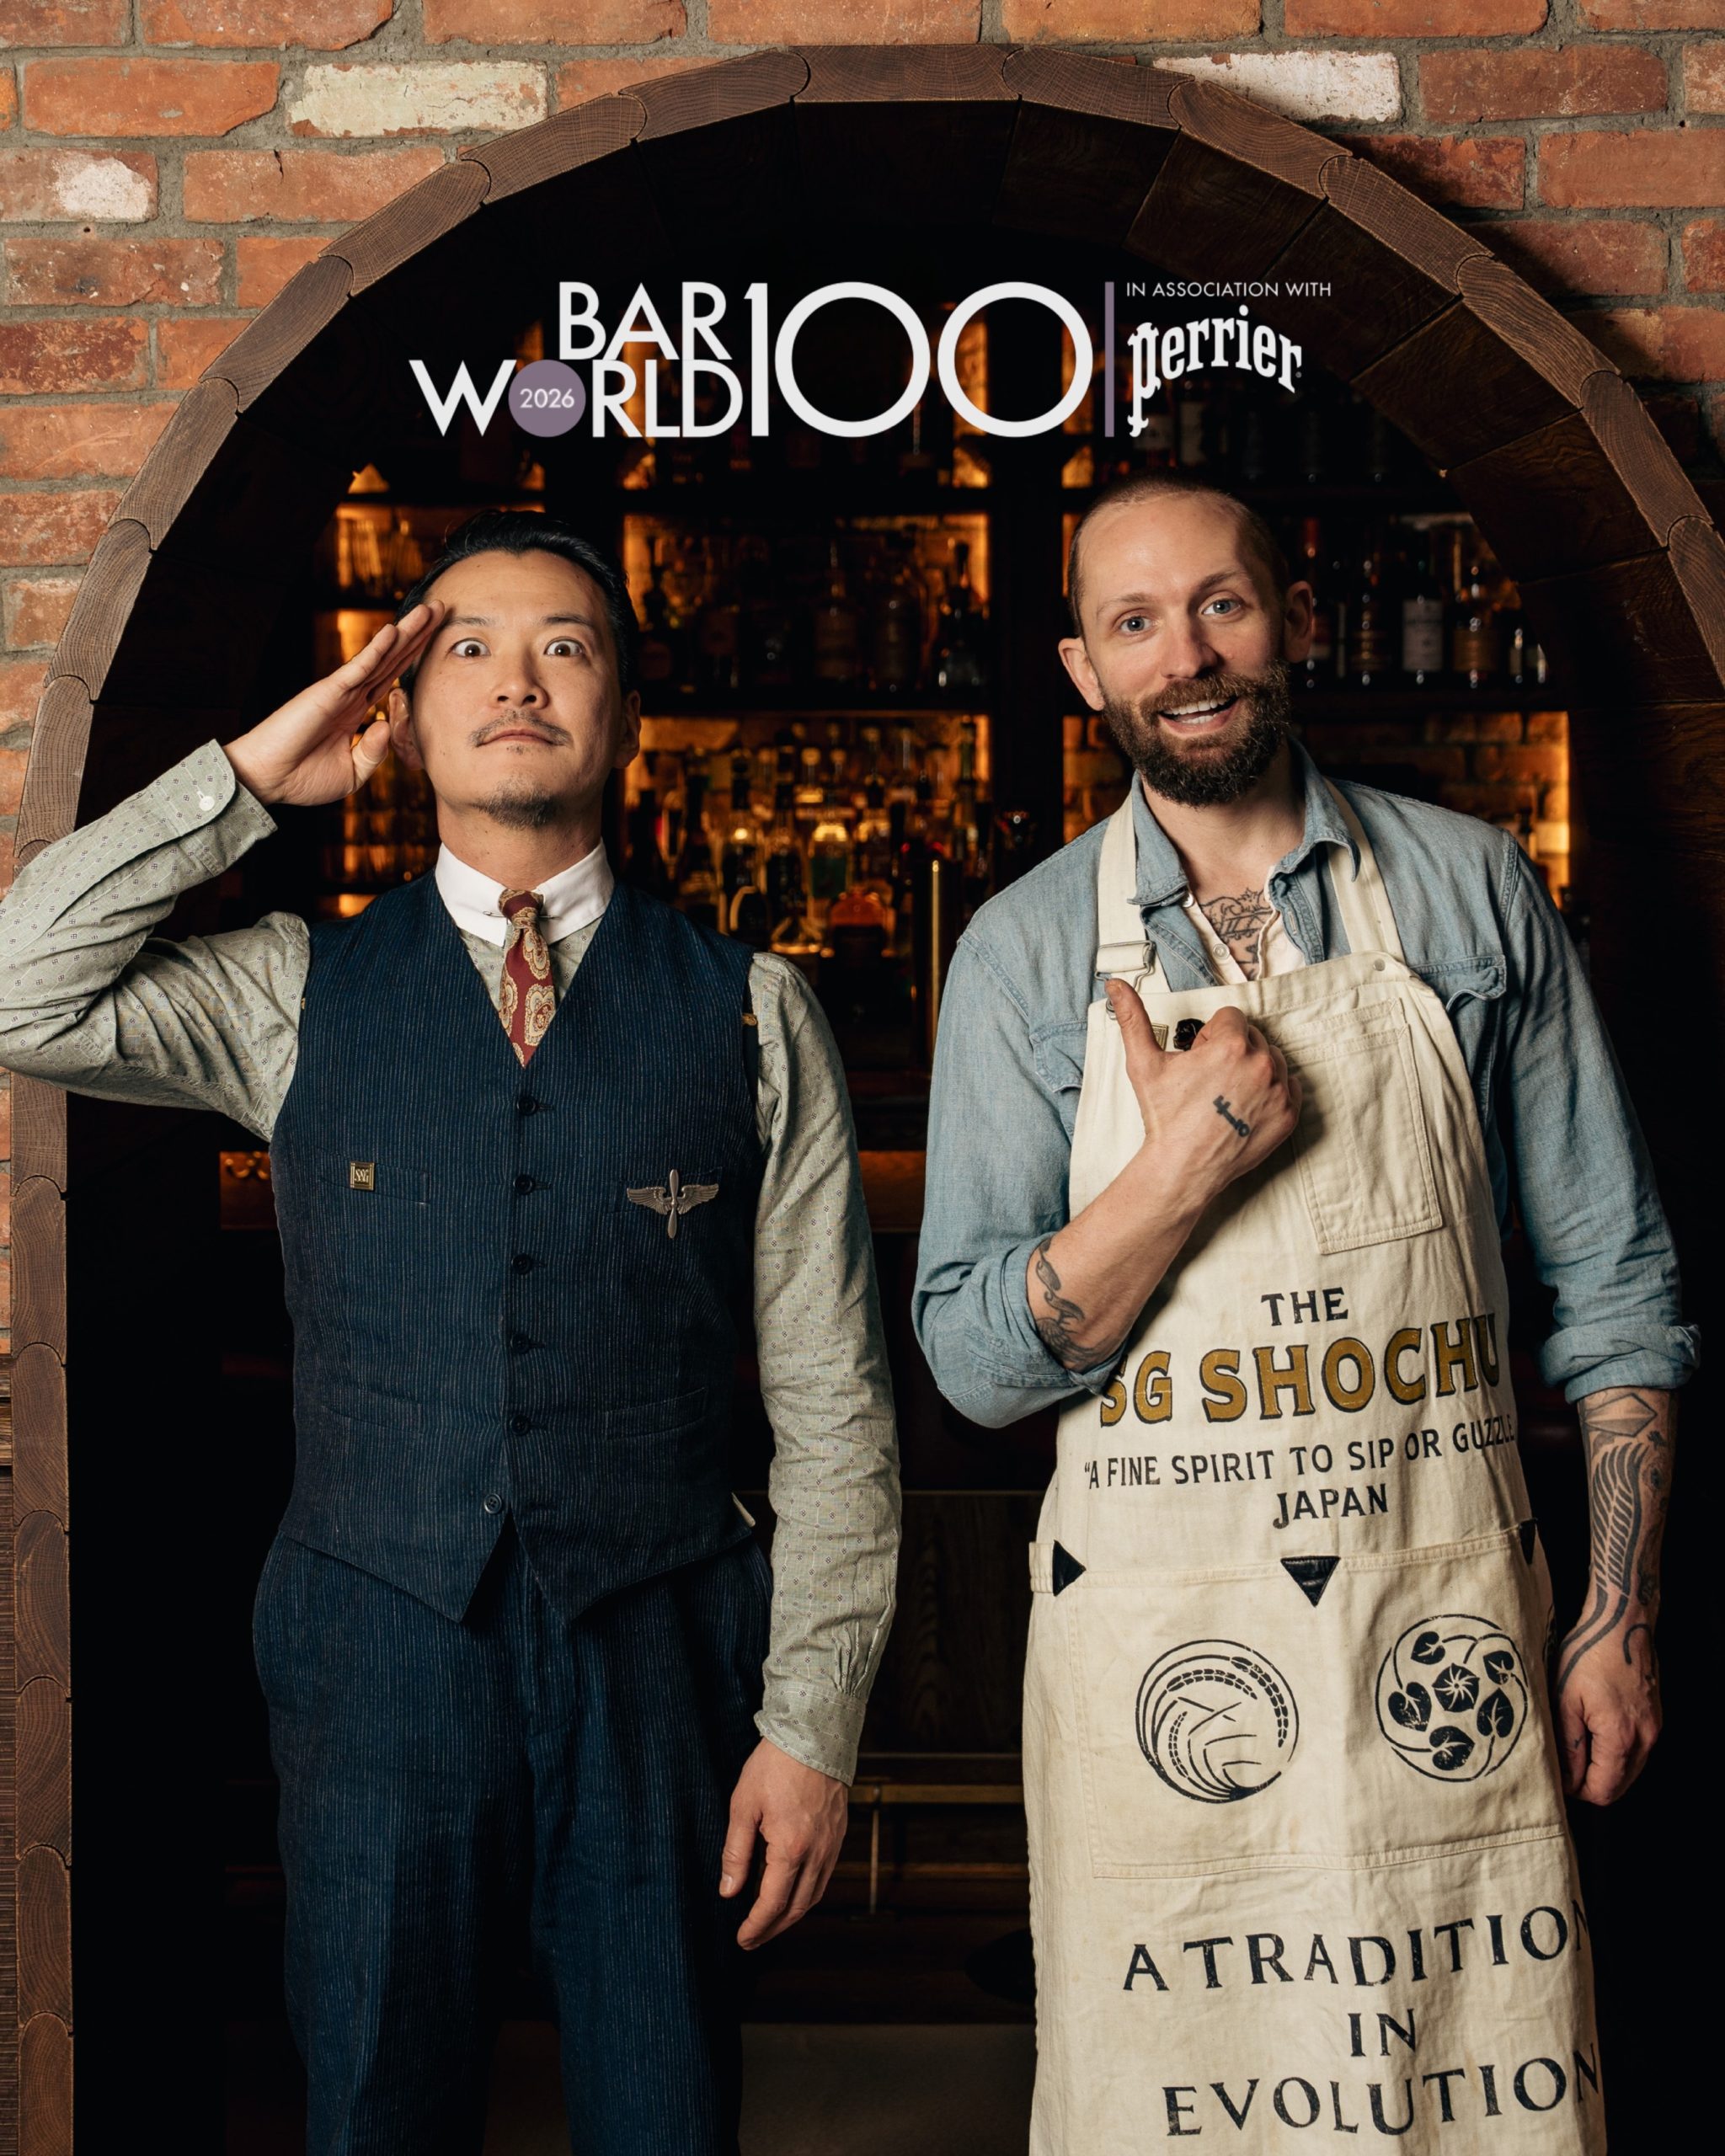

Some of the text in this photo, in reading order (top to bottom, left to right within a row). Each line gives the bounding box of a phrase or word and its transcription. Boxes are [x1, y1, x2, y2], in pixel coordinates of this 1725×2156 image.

[1261, 1287, 1348, 1326] THE
[1199, 1312, 1500, 1424] SHOCHU
[1108, 1455, 1161, 1486] FINE
[1171, 1449, 1274, 1485] SPIRIT
[1289, 1444, 1333, 1476] TO
[1347, 1438, 1395, 1472] SIP
[1403, 1428, 1443, 1462] OR
[1272, 1483, 1389, 1529] JAPAN
[1348, 2008, 1418, 2057] IN
[1162, 2042, 1599, 2137] EVOLUTION
